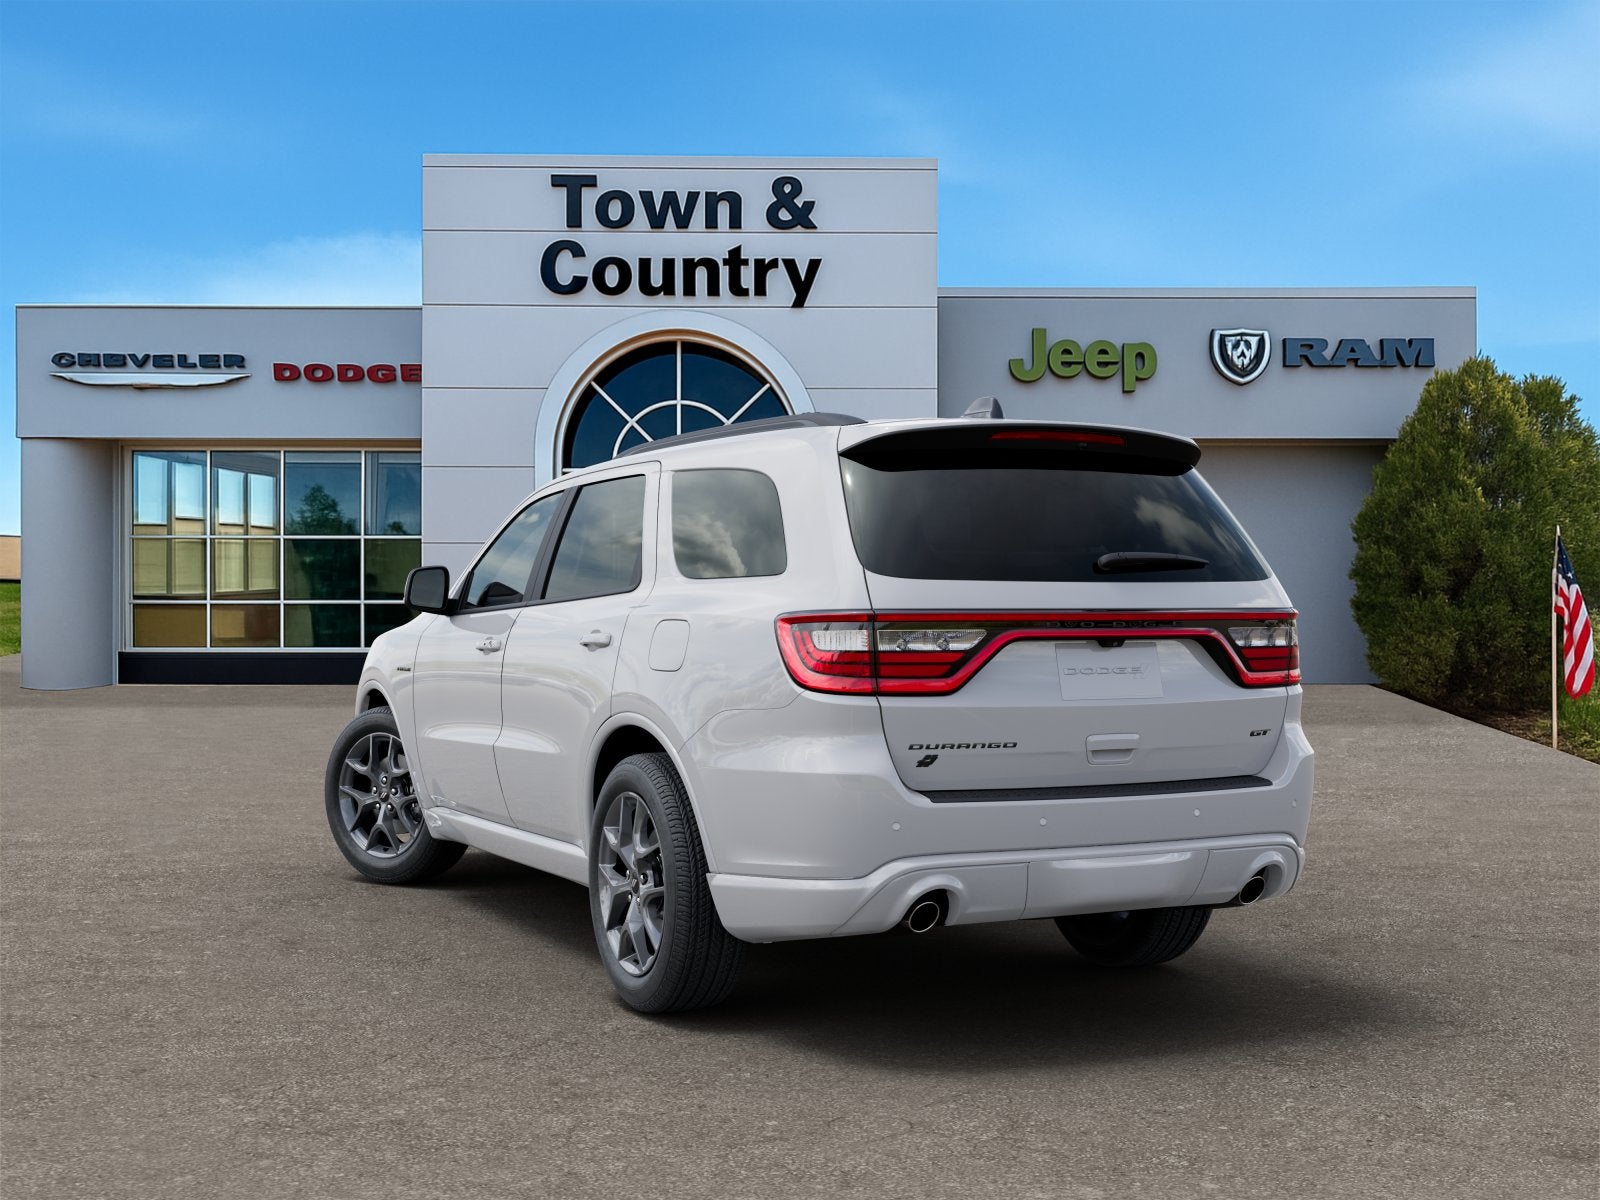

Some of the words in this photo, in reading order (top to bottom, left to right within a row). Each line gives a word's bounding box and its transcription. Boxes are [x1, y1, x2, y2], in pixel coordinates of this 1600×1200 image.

[551, 174, 742, 229] Town
[766, 176, 818, 230] &
[540, 239, 822, 308] Country
[1009, 328, 1157, 393] Jeep
[1282, 338, 1435, 367] RAM
[273, 363, 422, 383] DODGE
[1063, 666, 1144, 676] DODGE
[908, 742, 1018, 750] DURANGO
